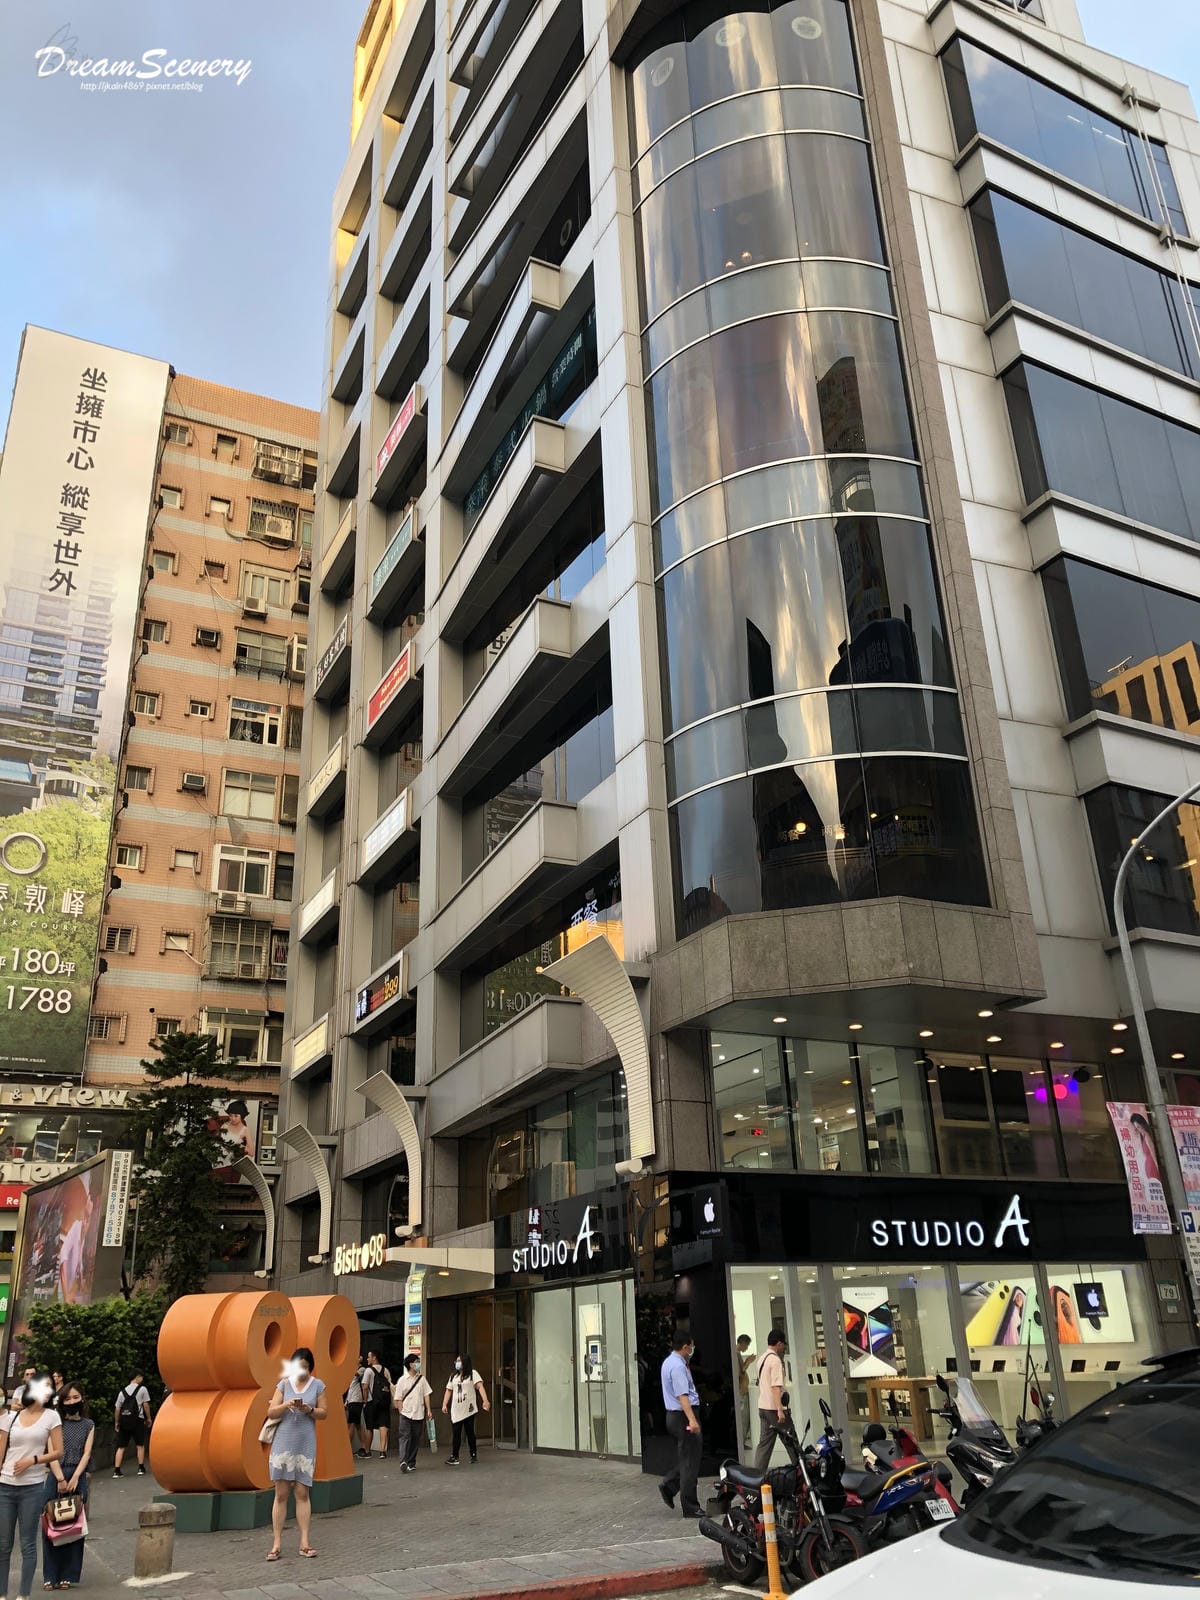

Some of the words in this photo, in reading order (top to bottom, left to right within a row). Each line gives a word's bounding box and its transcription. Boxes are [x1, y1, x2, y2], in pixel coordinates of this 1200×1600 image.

[67, 367, 109, 471] 坐擁市心
[48, 482, 91, 596] 縱享世外
[30, 920, 78, 932] COURT
[7, 985, 72, 1014] 1788
[512, 1240, 568, 1273] STUDIO
[572, 1205, 595, 1264] A
[871, 1219, 985, 1247] STUDIO
[994, 1194, 1030, 1248] A
[1183, 1214, 1192, 1230] P
[1163, 1287, 1174, 1298] 79
